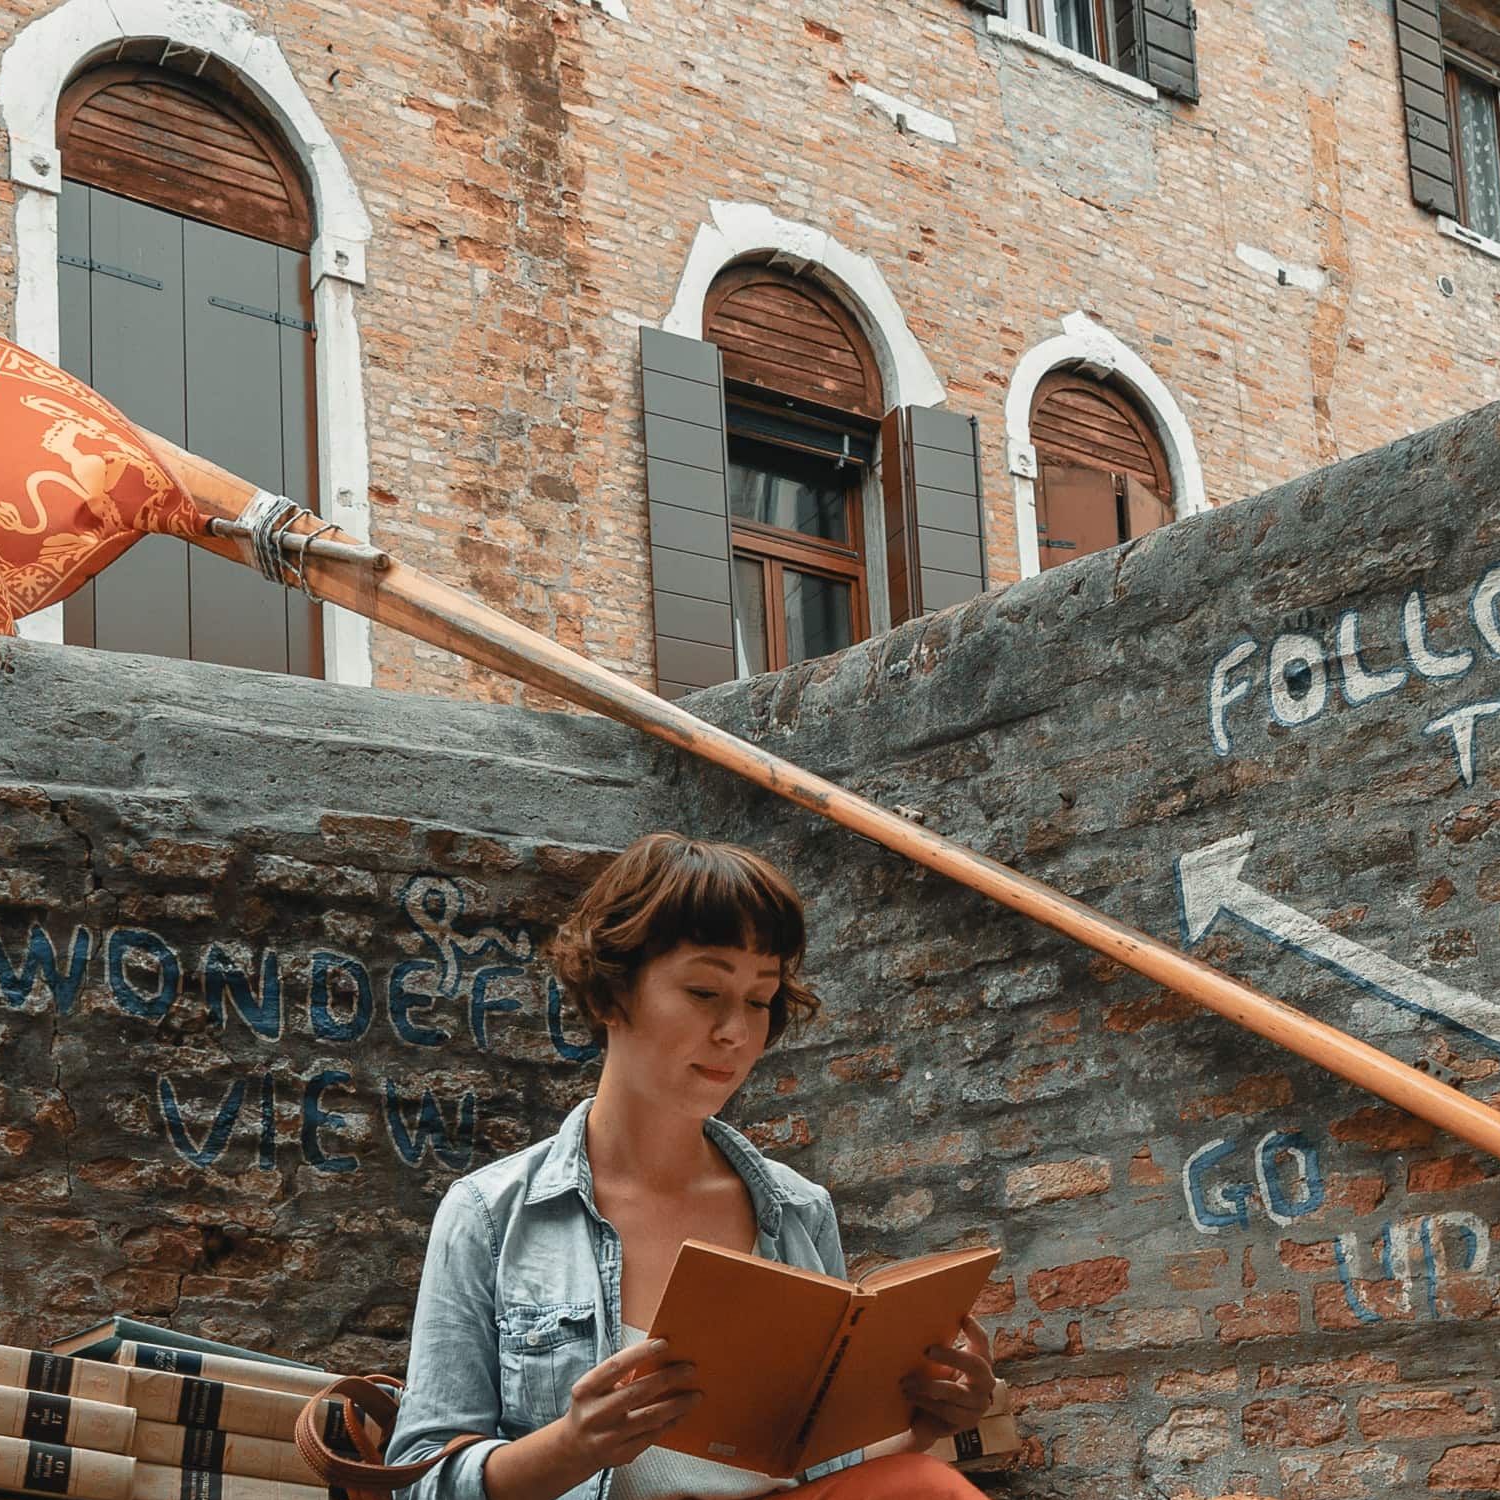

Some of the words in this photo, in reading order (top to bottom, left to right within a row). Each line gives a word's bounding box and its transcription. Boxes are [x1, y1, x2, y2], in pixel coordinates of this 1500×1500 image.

[159, 1070, 475, 1171] VIEW
[1181, 1130, 1323, 1234] GO
[1334, 1212, 1491, 1323] UP
